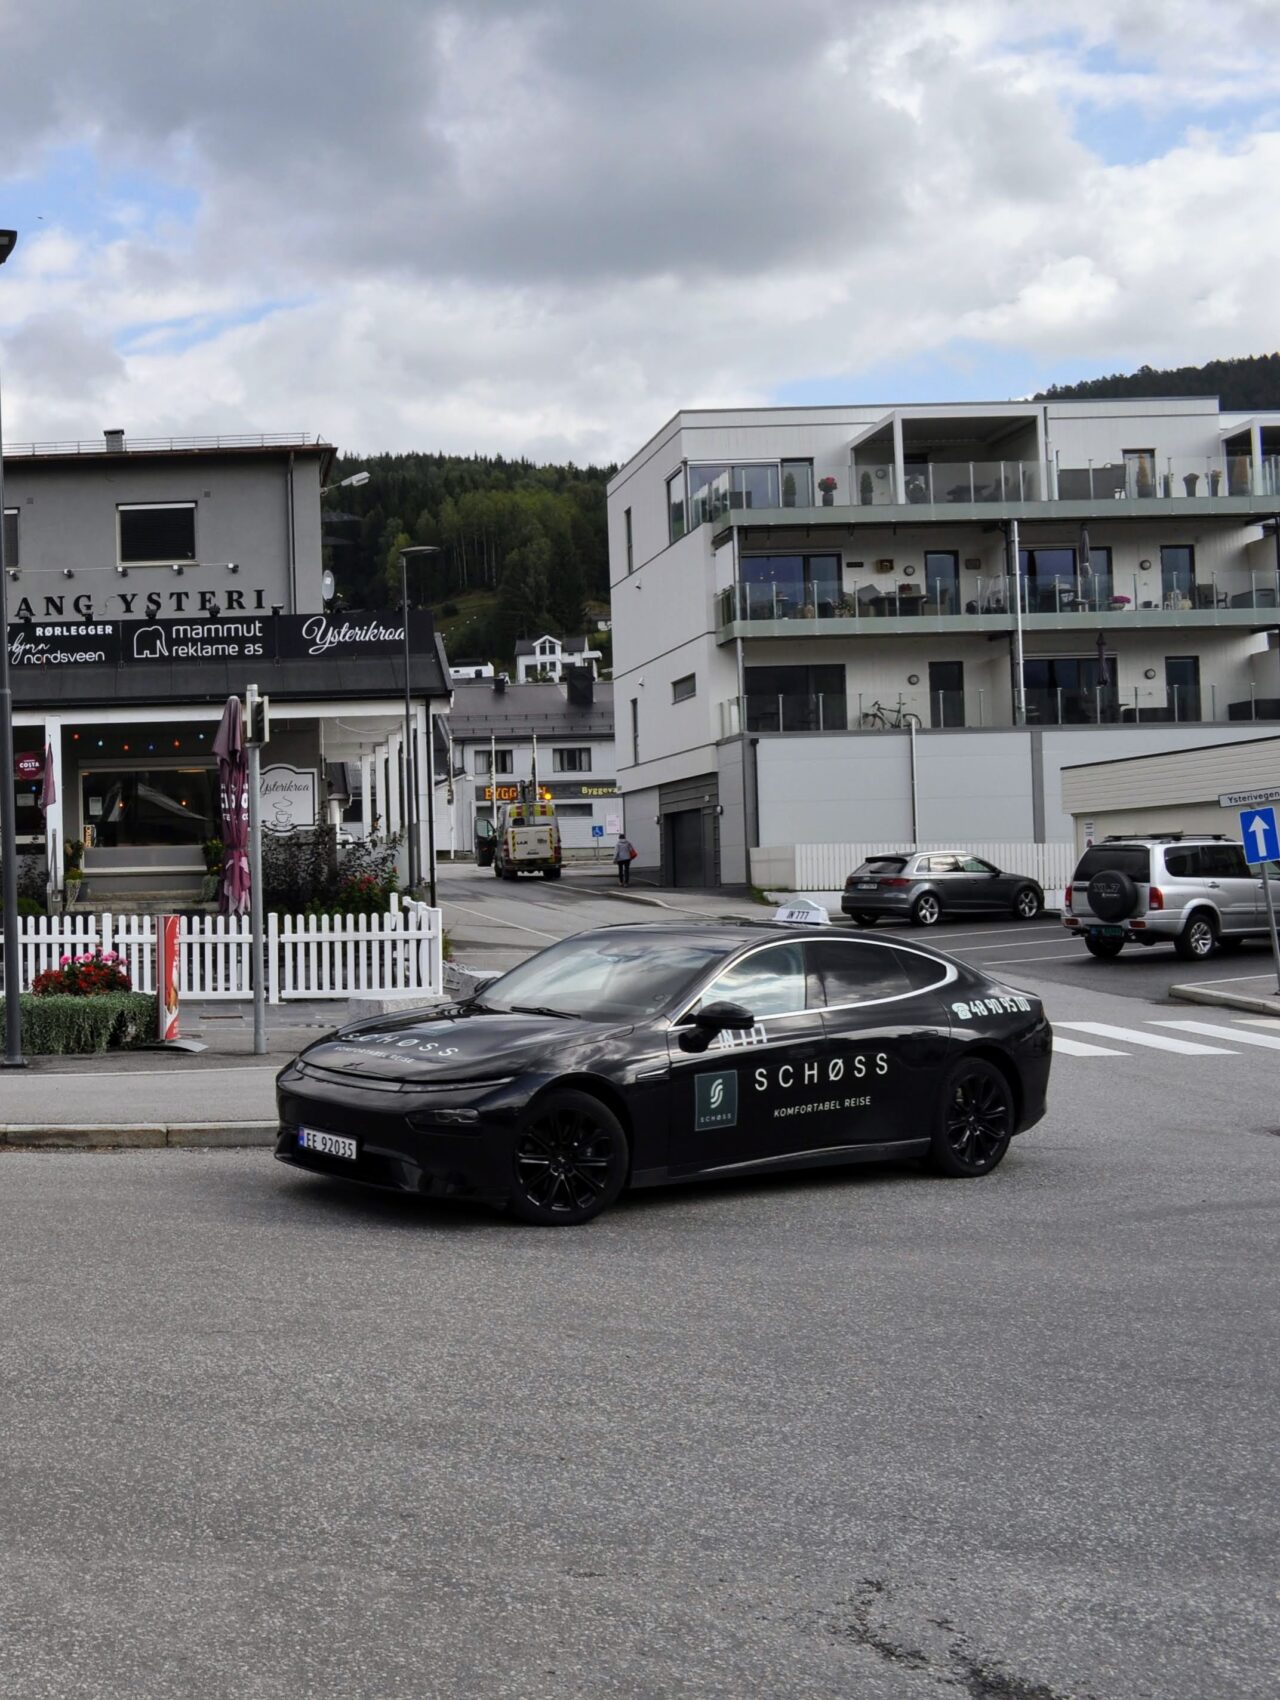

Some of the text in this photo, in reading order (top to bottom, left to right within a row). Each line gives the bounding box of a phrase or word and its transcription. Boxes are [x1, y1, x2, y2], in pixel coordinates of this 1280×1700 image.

[117, 589, 265, 613] YSTERI
[35, 625, 113, 636] RØRLEGGER
[172, 620, 263, 638] mammut
[302, 616, 405, 654] Ysterikroa
[24, 651, 105, 664] nordsveen
[172, 642, 263, 657] reklame as
[19, 761, 40, 769] COSTA
[1227, 791, 1280, 804] Ysterivegen
[796, 910, 810, 920] 777
[969, 1000, 988, 1016] 48
[984, 998, 1003, 1014] 90
[999, 997, 1017, 1013] 95
[754, 1052, 888, 1091] SCHØSS
[773, 1096, 871, 1118] KOMFORTABEL REISE
[307, 1132, 353, 1158] EE 92035
